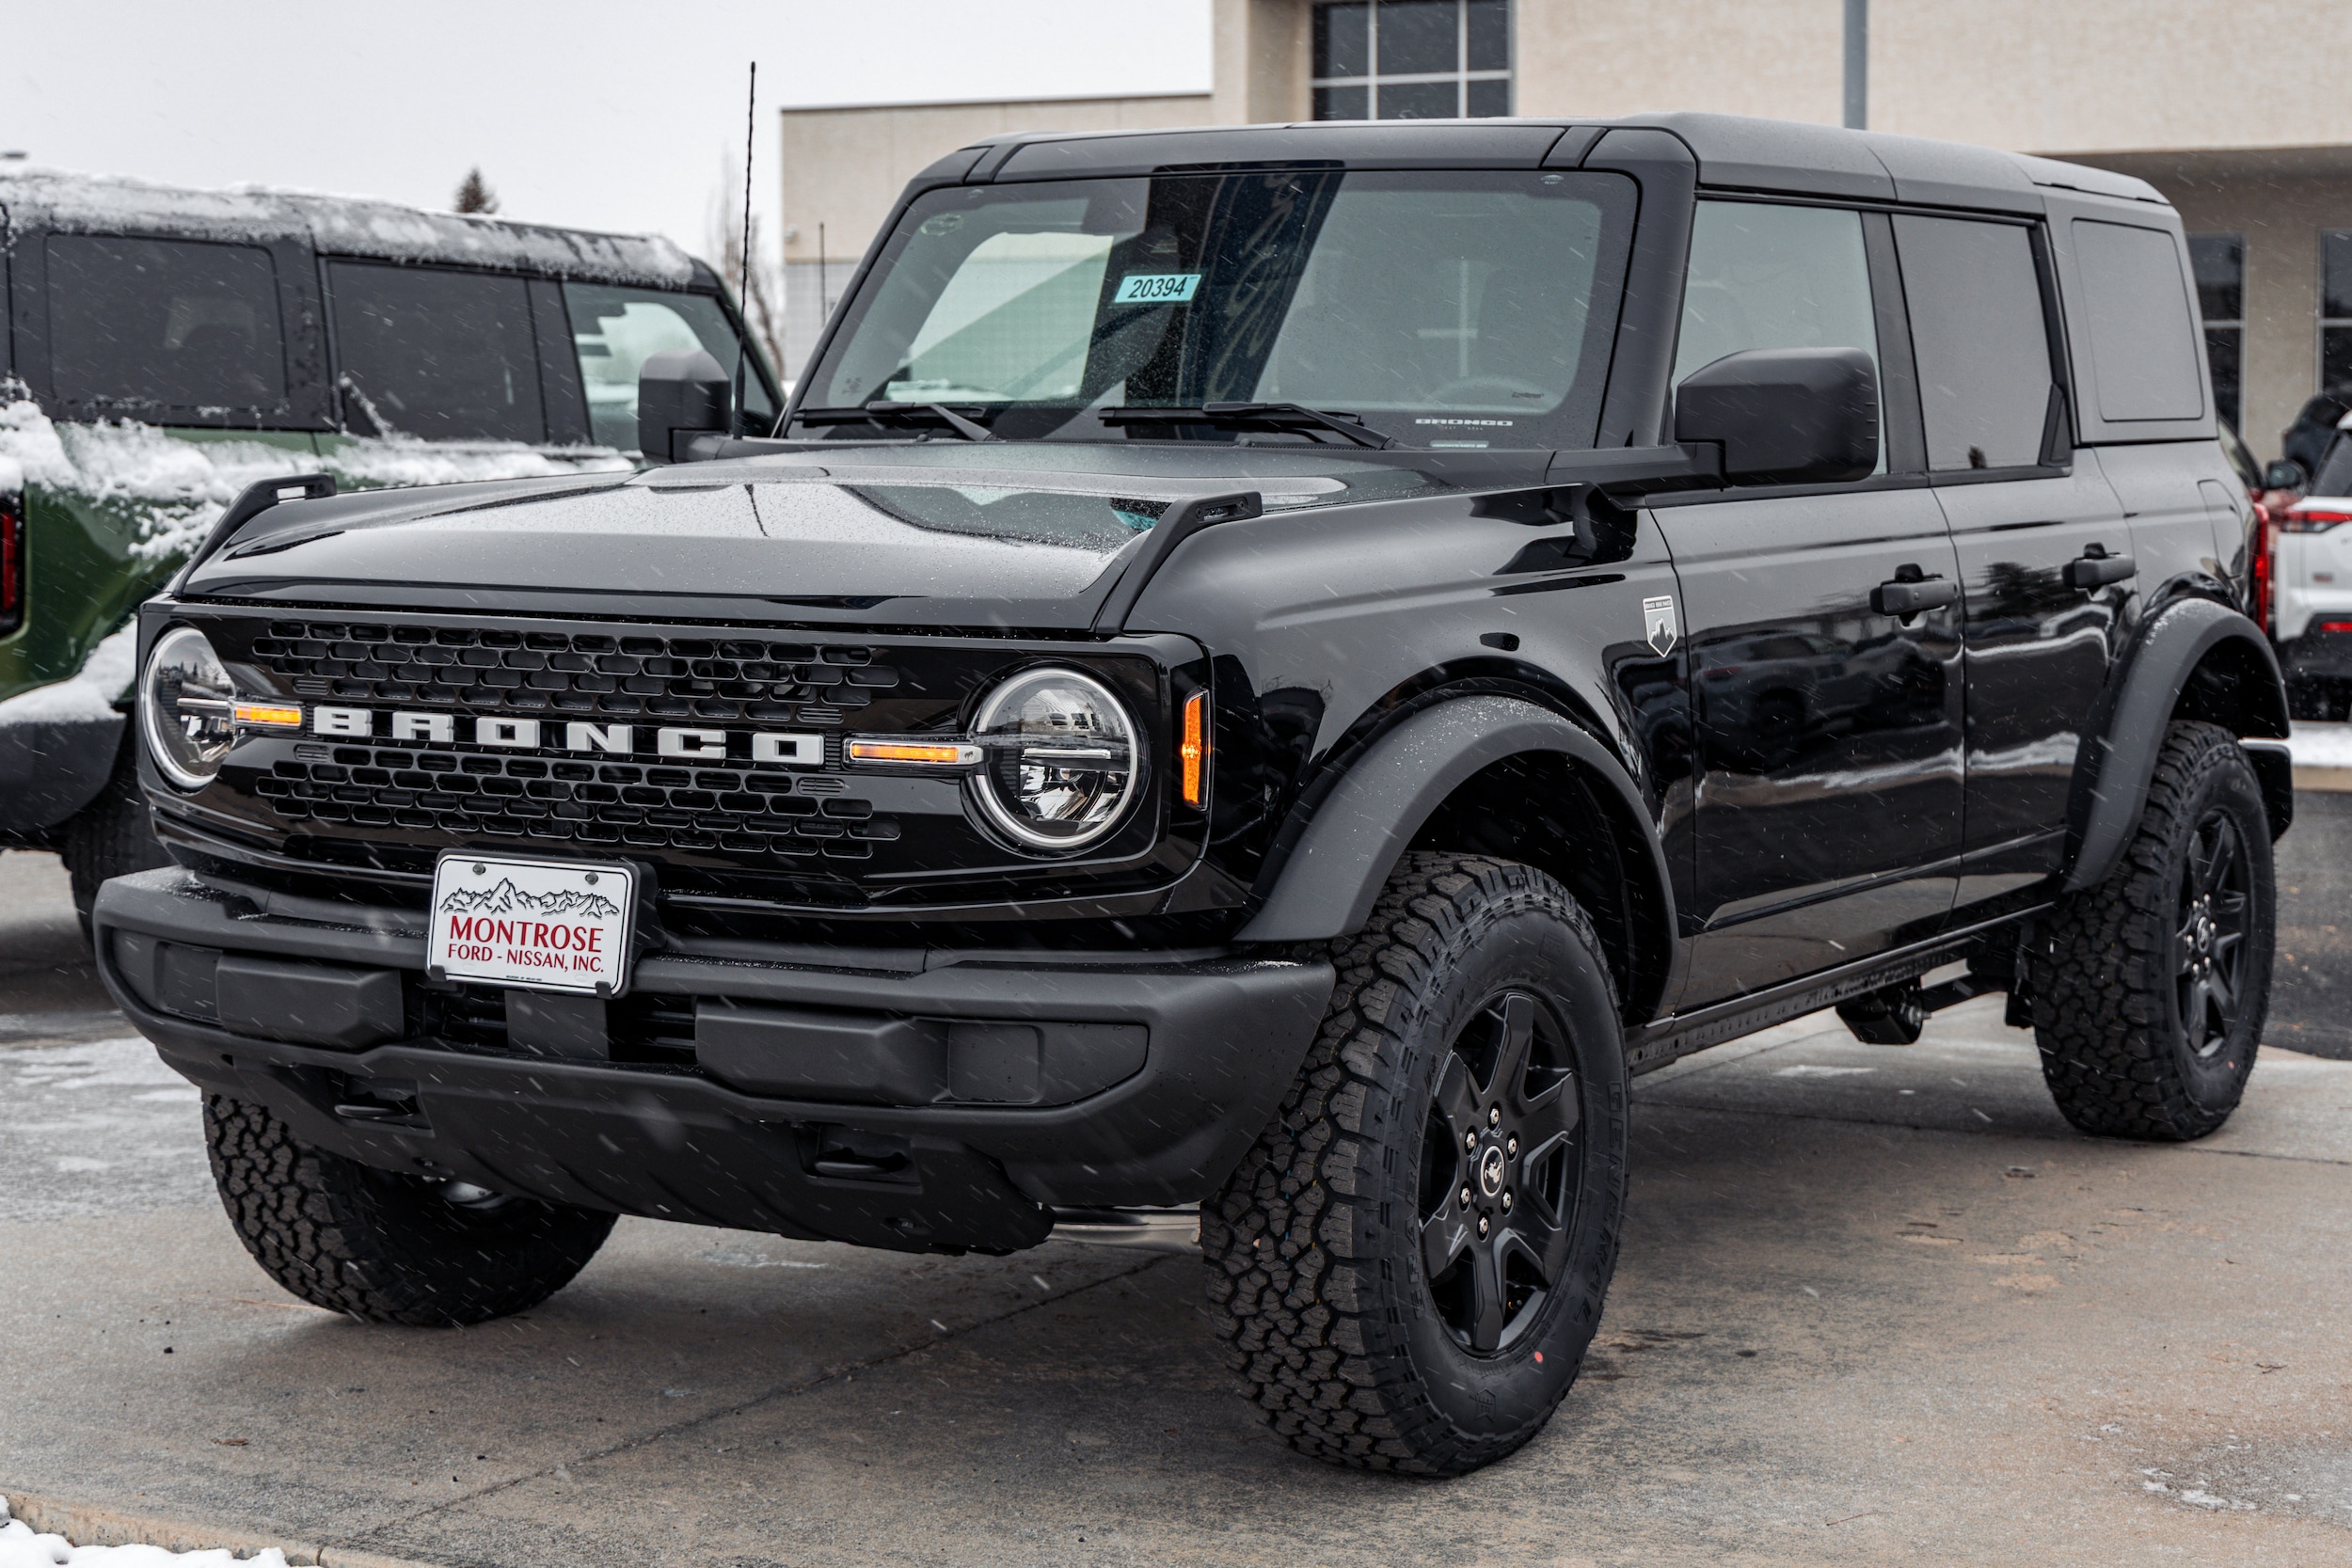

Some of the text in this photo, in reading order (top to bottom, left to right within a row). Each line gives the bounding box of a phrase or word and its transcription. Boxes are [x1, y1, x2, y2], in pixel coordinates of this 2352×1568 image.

[1128, 277, 1187, 298] 20394
[313, 705, 824, 765] BRONCO
[450, 915, 604, 953] MONTROSE
[448, 943, 493, 961] FORD
[506, 949, 568, 972] NISSAN,
[573, 956, 604, 973] INC.
[1574, 1082, 1624, 1324] GENERAL
